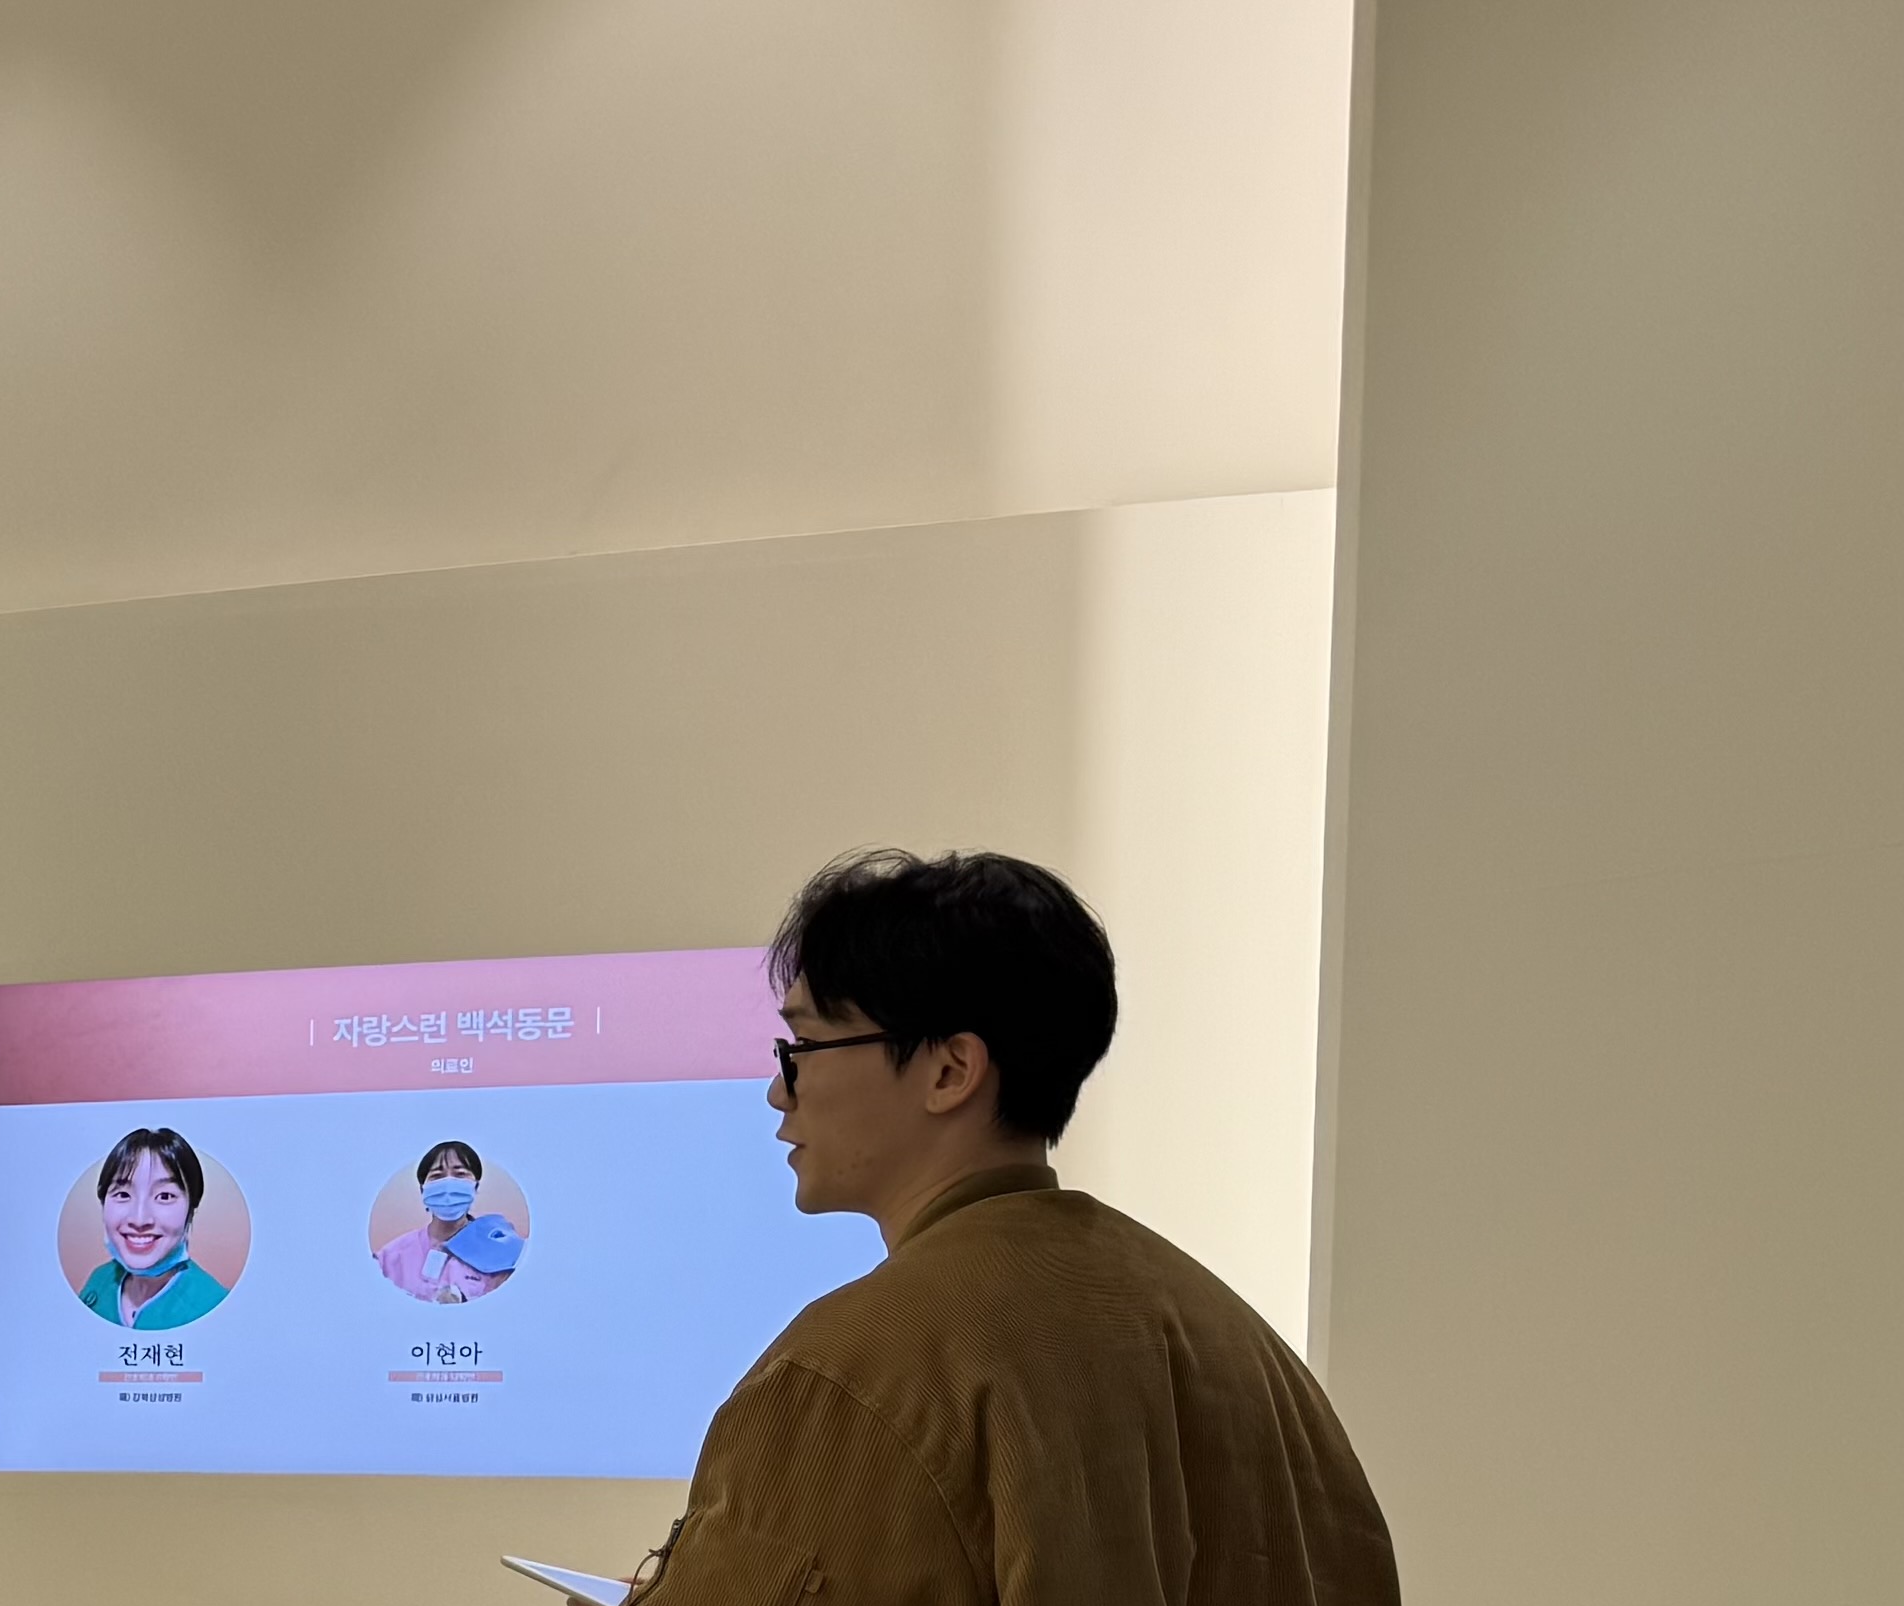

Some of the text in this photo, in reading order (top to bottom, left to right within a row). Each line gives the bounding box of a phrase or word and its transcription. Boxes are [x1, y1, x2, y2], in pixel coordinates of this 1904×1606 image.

[333, 1006, 575, 1047] 자랑스런 백석동문
[431, 1057, 474, 1074] 의료인
[119, 1344, 183, 1366] 전재현
[412, 1342, 482, 1365] 이현아
